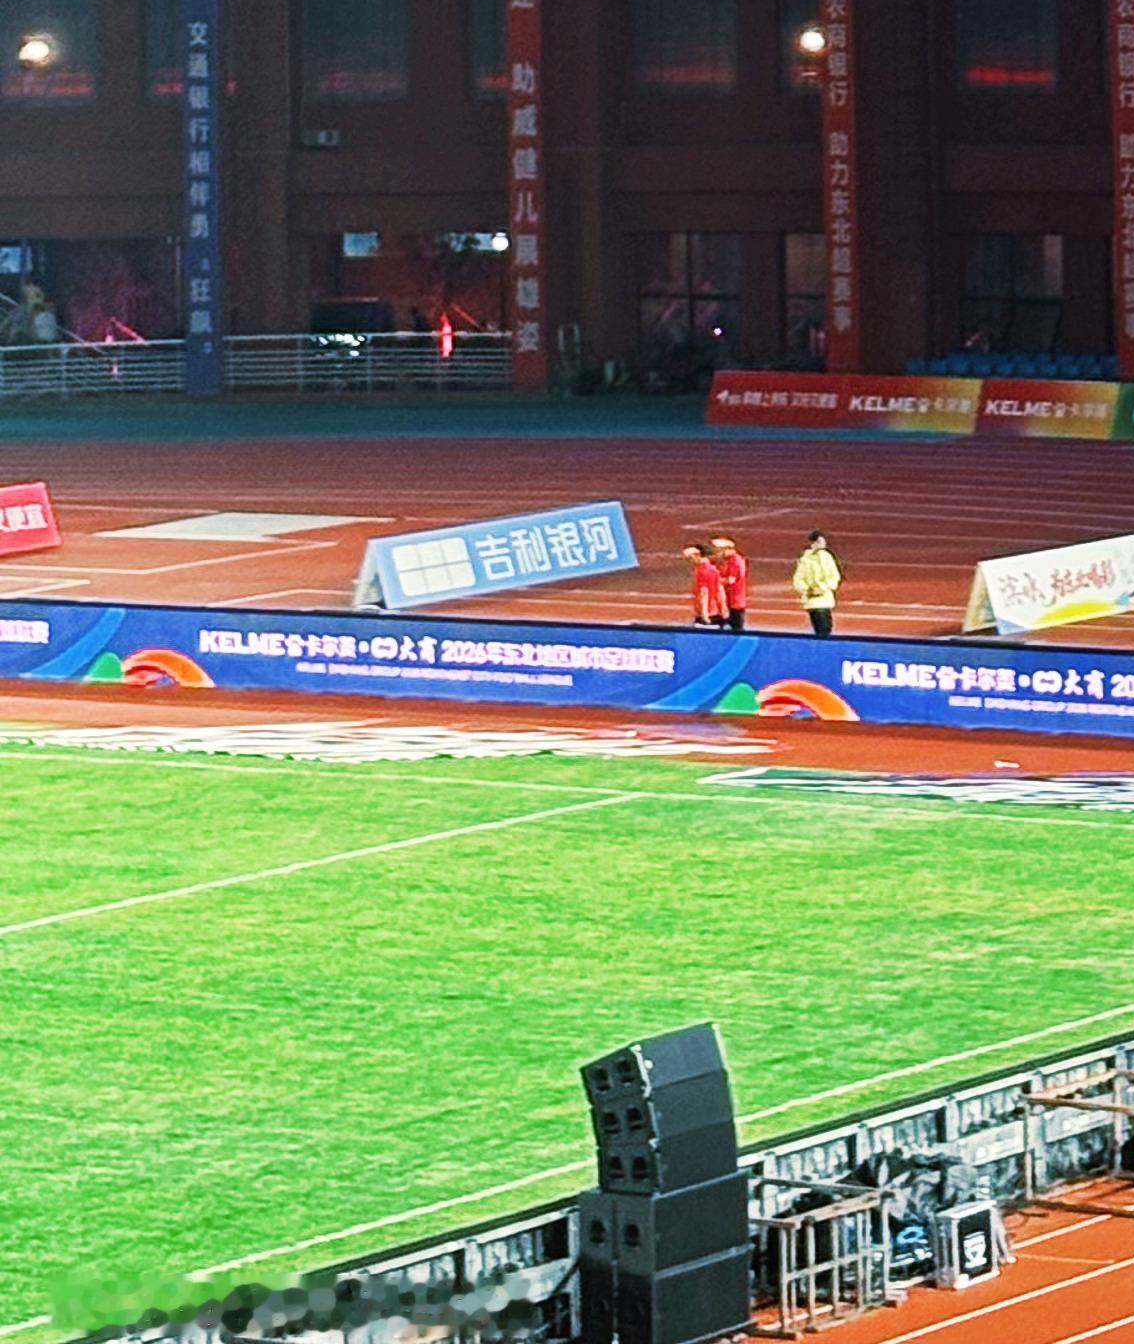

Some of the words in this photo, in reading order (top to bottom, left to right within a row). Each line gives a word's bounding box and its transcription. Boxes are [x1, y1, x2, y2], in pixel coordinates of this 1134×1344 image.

[828, 132, 852, 334] 助力东北超赛事
[849, 395, 916, 412] KELME
[985, 399, 1053, 417] KELME
[475, 516, 619, 581] 吉利银河
[200, 630, 286, 656] KELME
[842, 661, 938, 689] KELME
